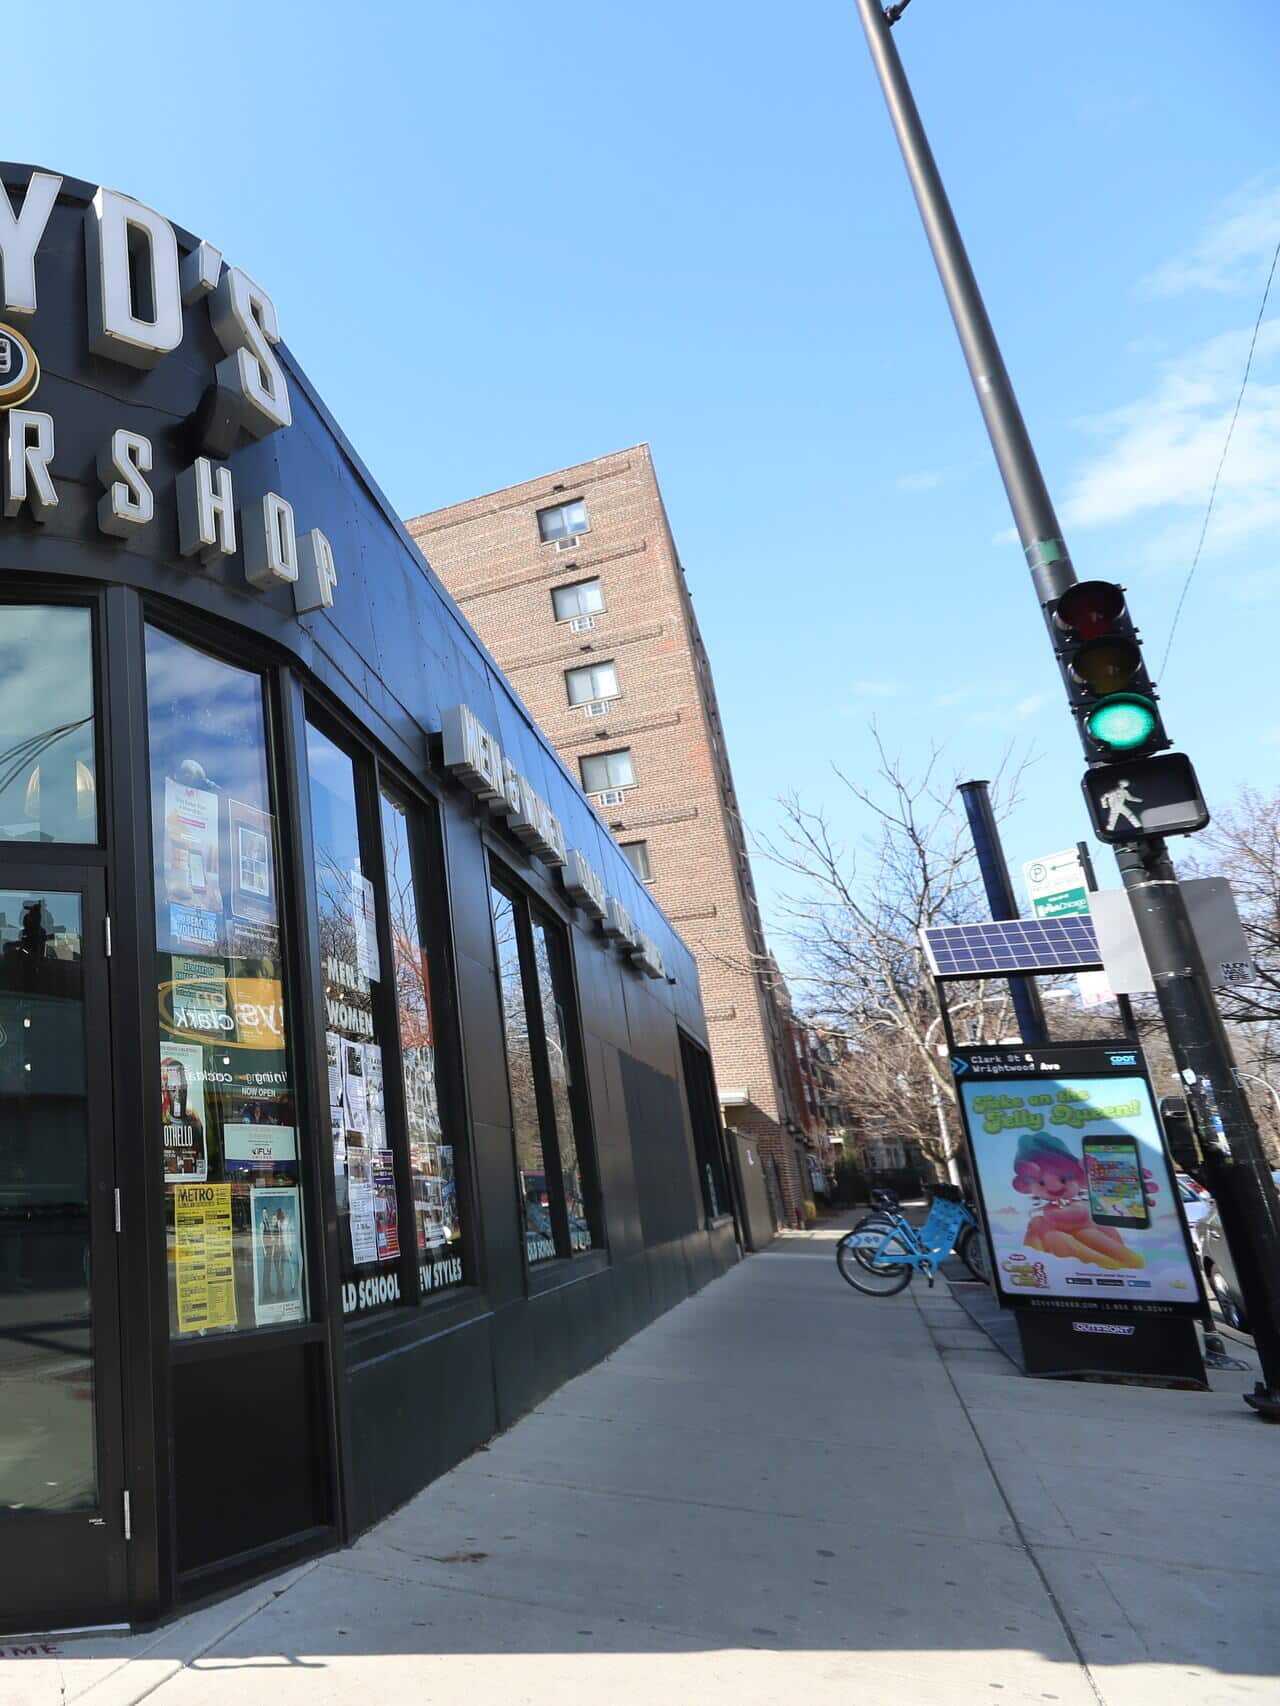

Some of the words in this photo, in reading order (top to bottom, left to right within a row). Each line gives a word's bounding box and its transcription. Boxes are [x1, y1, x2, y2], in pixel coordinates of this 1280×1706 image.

[324, 994, 374, 1037] WOMEN
[971, 1055, 1002, 1064] Clark
[1007, 1054, 1020, 1062] St
[973, 1062, 1035, 1074] Wrightwood
[1040, 1062, 1061, 1071] Ave
[163, 1125, 193, 1147] OTHELLO
[178, 1187, 214, 1202] METRO
[342, 1282, 357, 1313] LD
[359, 1273, 401, 1309] SCHOOL
